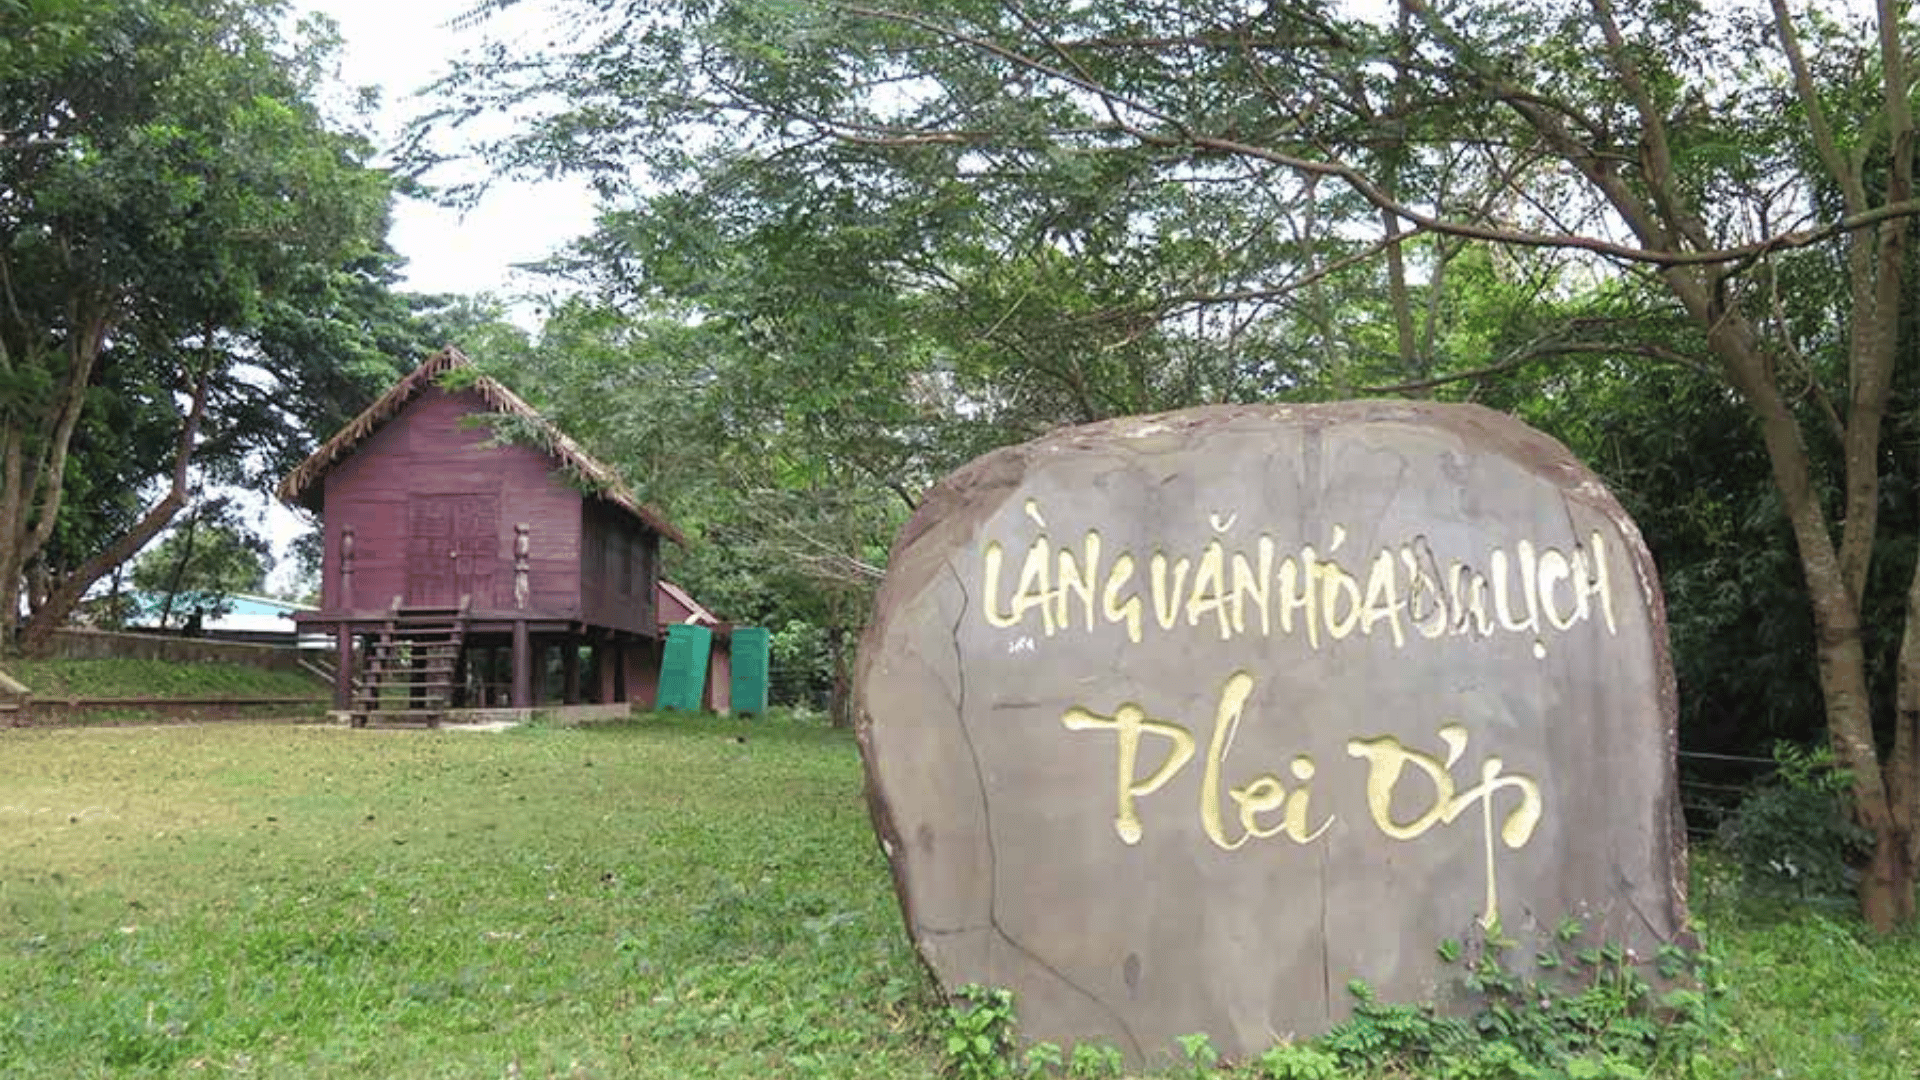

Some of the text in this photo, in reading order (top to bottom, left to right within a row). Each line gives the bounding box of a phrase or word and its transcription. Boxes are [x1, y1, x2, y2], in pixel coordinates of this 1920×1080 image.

[984, 497, 1143, 643] LÀNG
[1151, 510, 1274, 640] VĂN
[1277, 523, 1406, 650] HÓA
[1491, 528, 1618, 660] LỊCH
[1060, 671, 1335, 851] Plei
